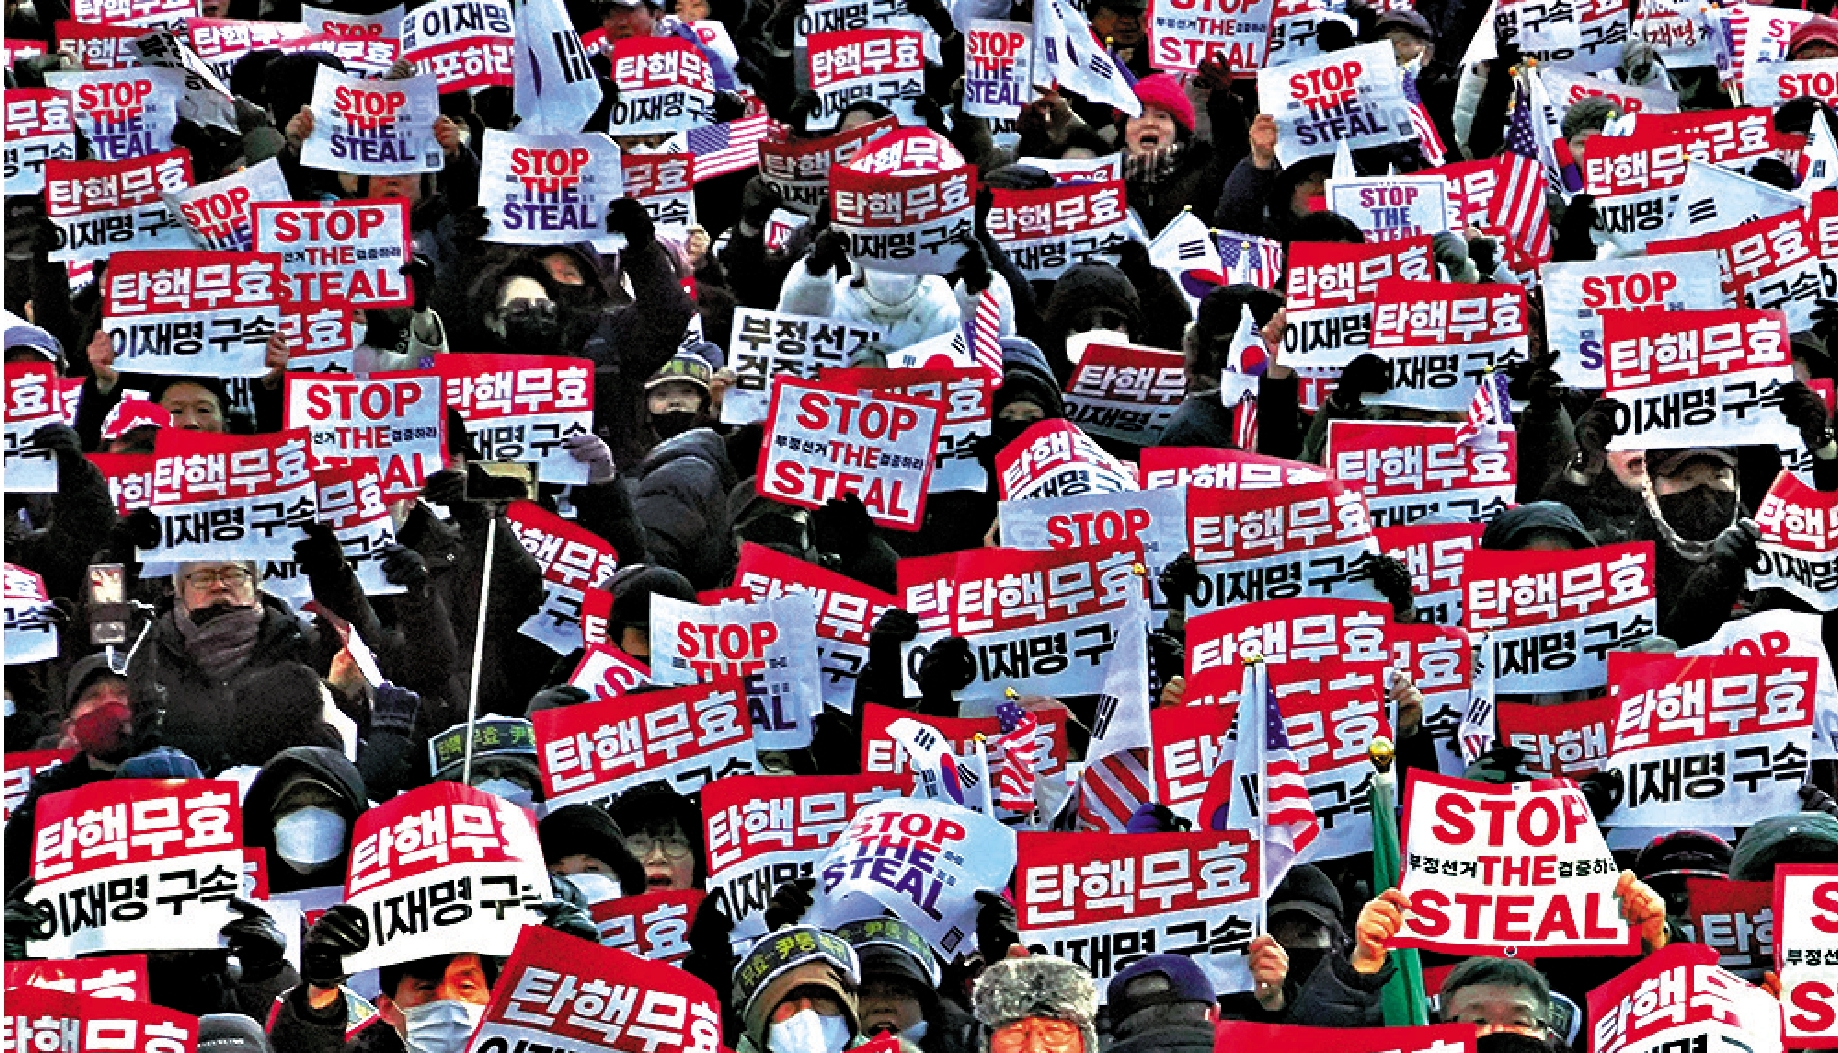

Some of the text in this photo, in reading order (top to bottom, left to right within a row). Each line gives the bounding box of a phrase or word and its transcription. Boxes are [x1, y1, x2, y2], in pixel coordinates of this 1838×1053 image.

[811, 33, 922, 83] 탄핵무효
[967, 31, 1023, 56] STOP
[79, 81, 151, 109] STOP
[334, 84, 405, 112] STOP
[1290, 61, 1363, 99] STOP
[331, 137, 415, 163] STEAL
[1300, 110, 1389, 148] STEAL
[510, 147, 590, 174] STOP
[49, 158, 192, 212] 탄핵무효
[522, 173, 579, 202] THE
[834, 168, 975, 223] 탄핵무효
[1360, 187, 1418, 209] STOP
[275, 208, 385, 243] STOP
[502, 201, 598, 230] STEAL
[109, 252, 274, 308] 탄핵무효
[1584, 272, 1677, 308] STOP
[109, 313, 278, 355] 이재명 구속
[1285, 316, 1370, 353] 이재명
[1374, 292, 1524, 343] 탄핵무효
[1608, 317, 1787, 385] 탄핵무효
[306, 383, 422, 420] STOP
[797, 392, 917, 441] STOP
[1613, 390, 1717, 436] 이재명
[336, 426, 390, 449] THE
[829, 441, 878, 469] THE
[153, 447, 311, 502] 탄핵무효
[1048, 508, 1150, 549] STOP
[1193, 490, 1370, 561] 탄핵무효
[957, 552, 1143, 636] 탄핵무효
[1197, 555, 1300, 608] 이재명
[1469, 552, 1650, 632] 탄핵무효
[677, 621, 777, 661] STOP
[1616, 668, 1810, 752] 탄핵무효
[550, 692, 749, 796] 탄핵무효
[1733, 746, 1810, 794] 구속
[37, 795, 235, 881] 탄핵무효
[1432, 792, 1590, 848] STOP
[159, 864, 240, 915] 구속
[1026, 848, 1252, 928] 탄핵무효
[1478, 854, 1557, 886] THE
[1406, 889, 1617, 943] STEAL
